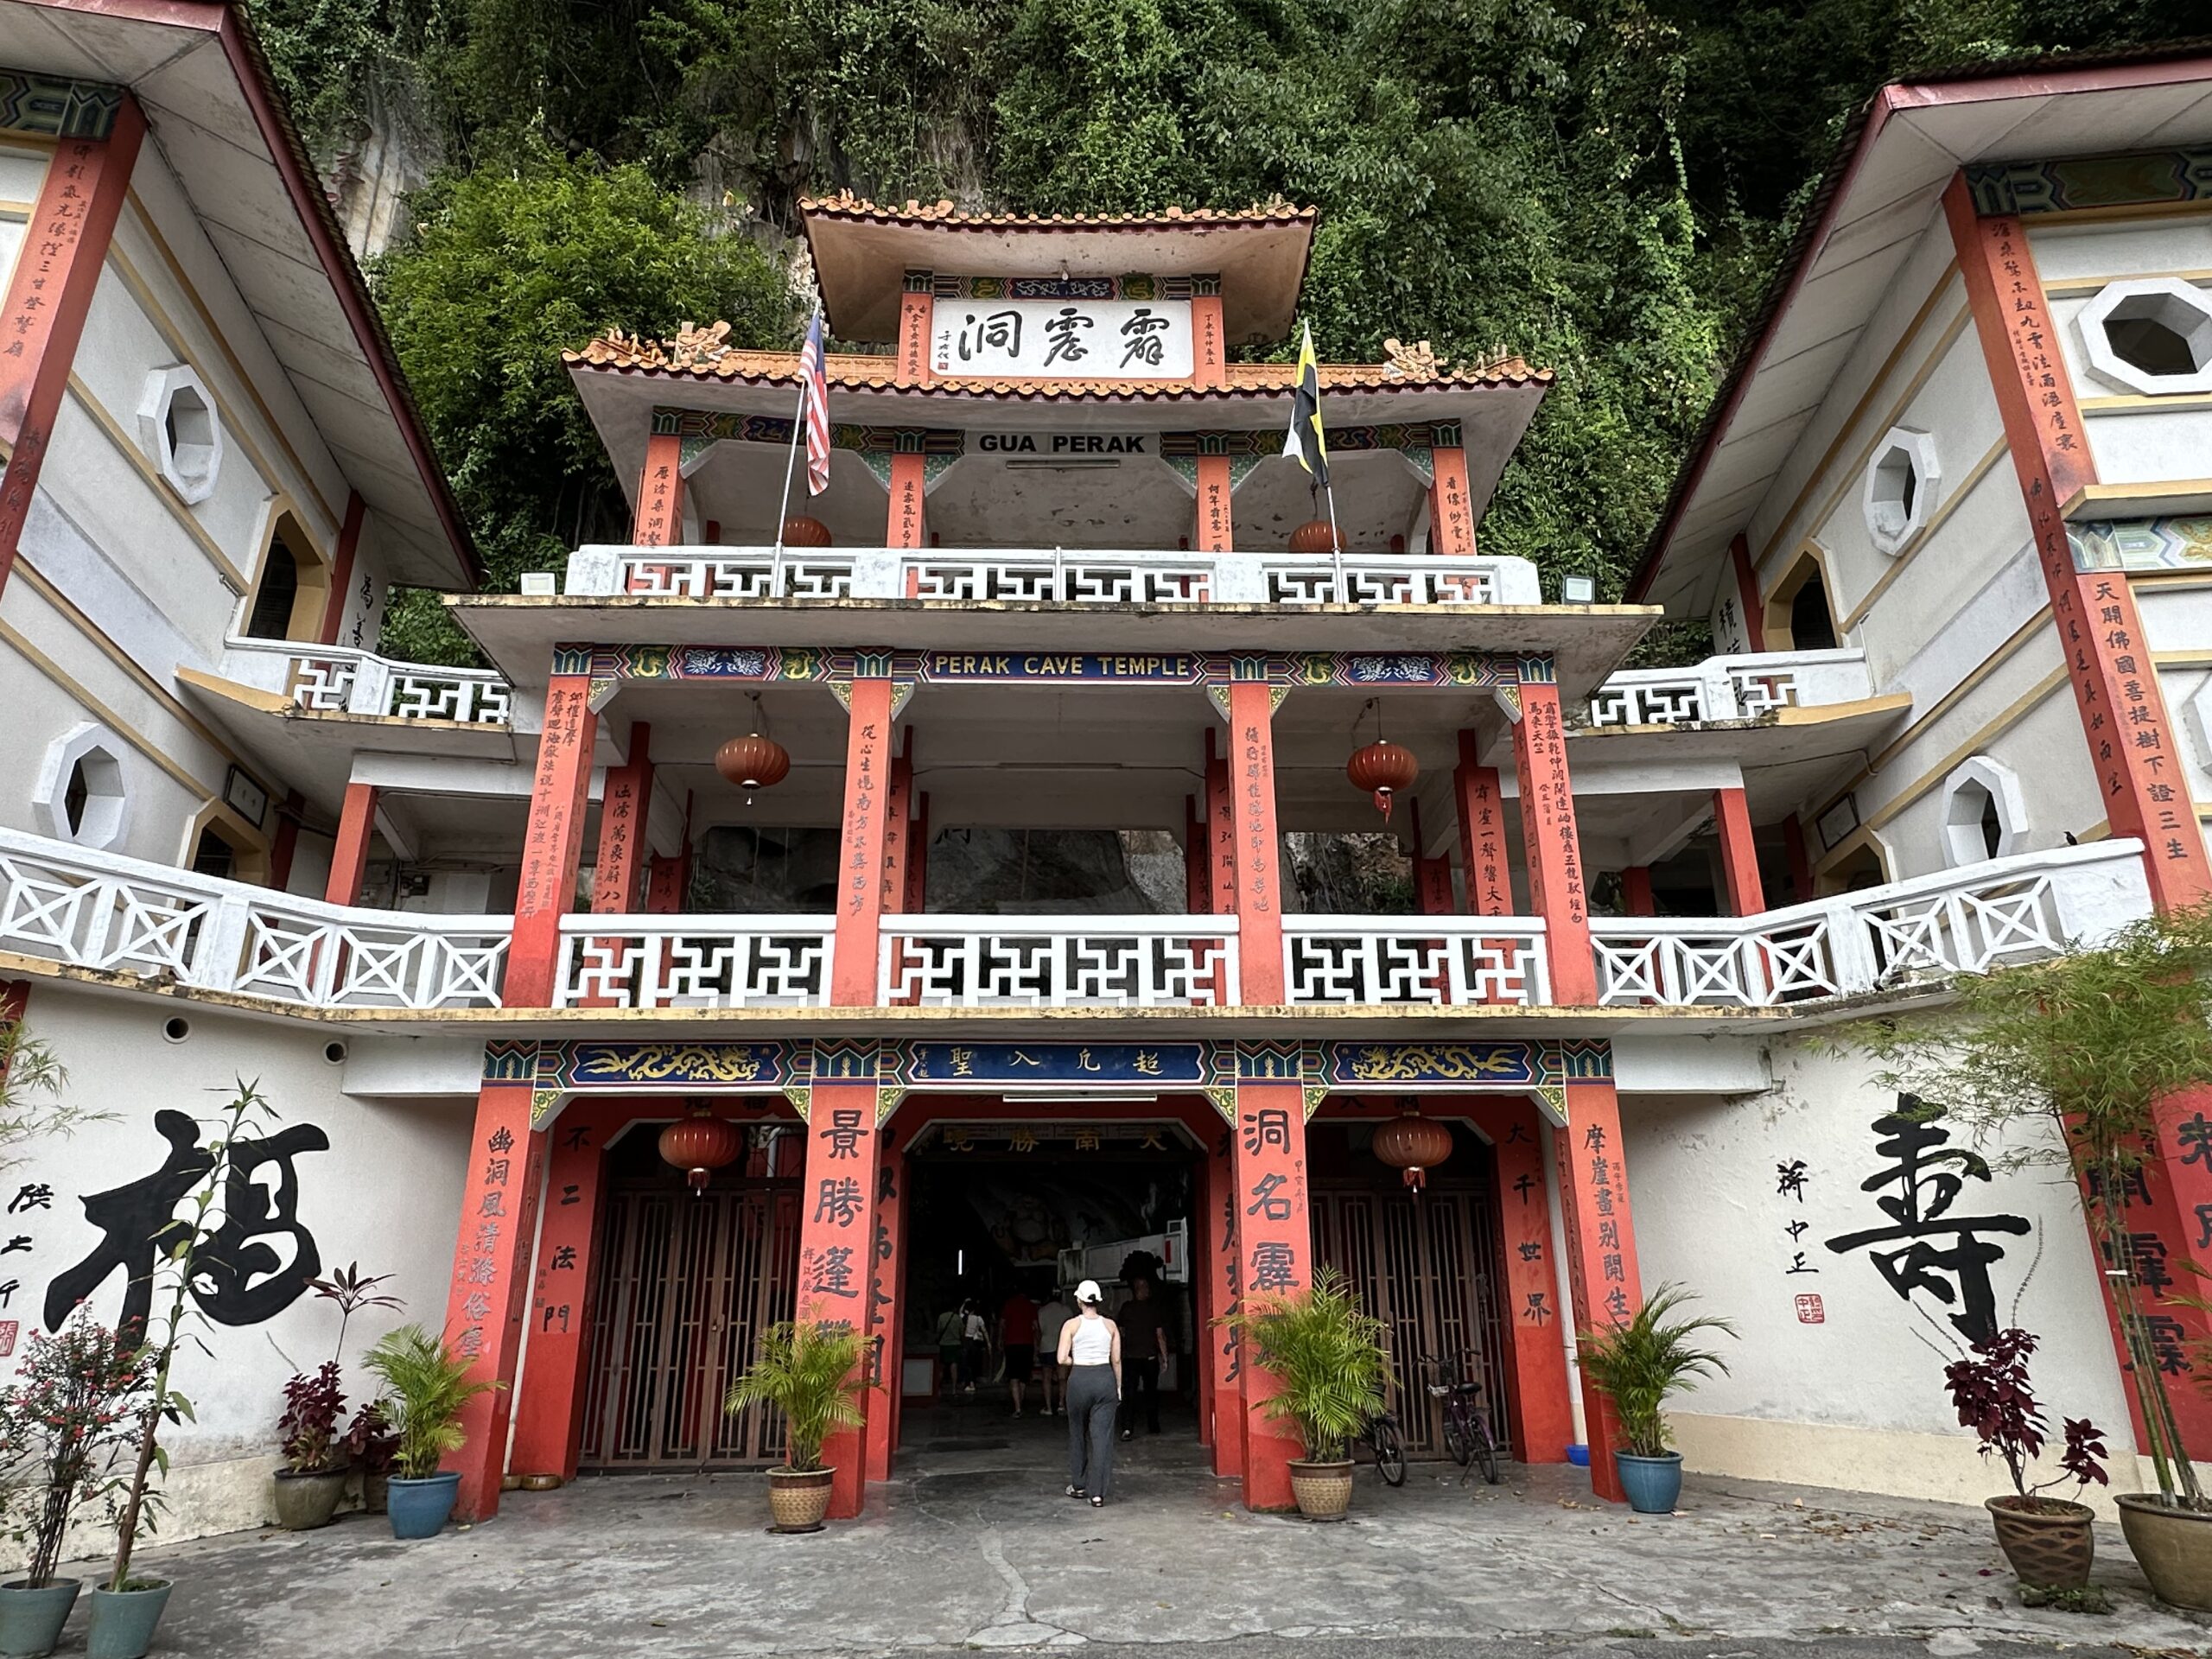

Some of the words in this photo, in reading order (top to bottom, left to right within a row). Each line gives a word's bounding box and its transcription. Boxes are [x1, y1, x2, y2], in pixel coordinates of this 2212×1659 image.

[979, 435, 1037, 453] GUA
[1052, 435, 1145, 454] PERAK
[935, 655, 1010, 675] PERAK
[1024, 656, 1084, 676] CAVE
[1097, 657, 1190, 677] TEMPLE
[44, 1109, 330, 1351] 福
[543, 1126, 592, 1334] 不二法門
[1504, 1122, 1551, 1327] 大千世界
